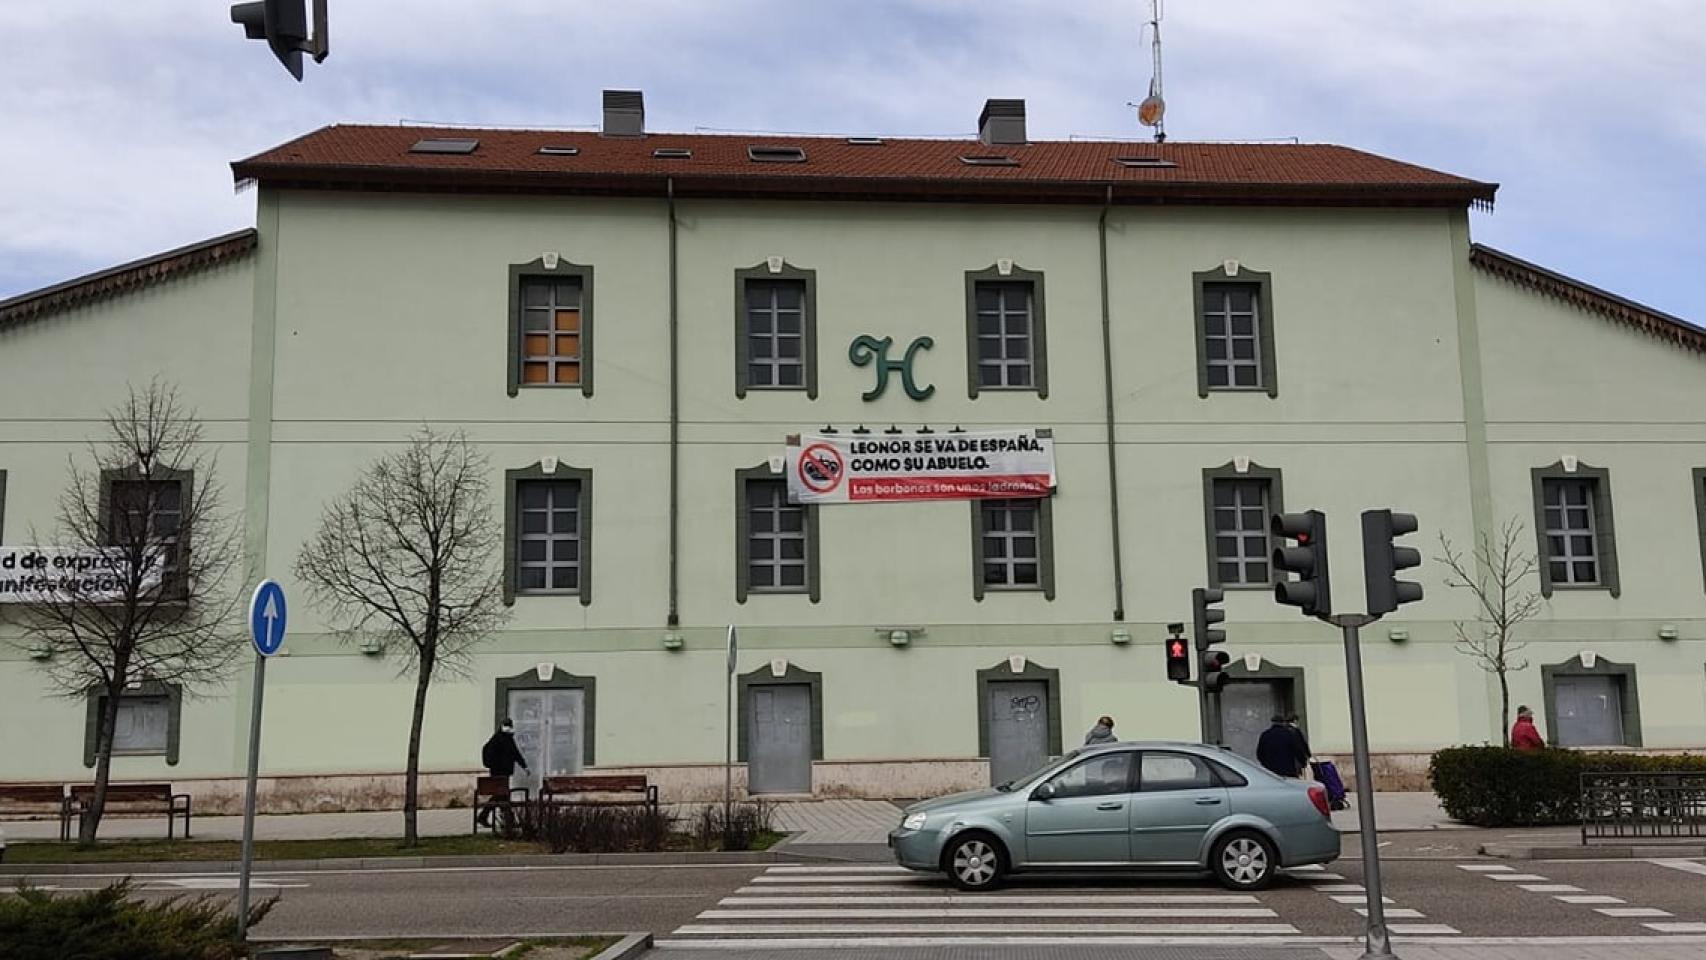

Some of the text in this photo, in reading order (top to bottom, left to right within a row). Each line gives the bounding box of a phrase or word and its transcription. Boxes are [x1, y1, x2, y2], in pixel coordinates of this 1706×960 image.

[848, 334, 936, 402] H
[850, 433, 1044, 454] LEONOR SE VA DE ESPAÑA,
[850, 455, 991, 471] COMO SU ABUELO.
[853, 483, 873, 495] Los
[932, 482, 955, 493] son
[20, 551, 49, 568] de
